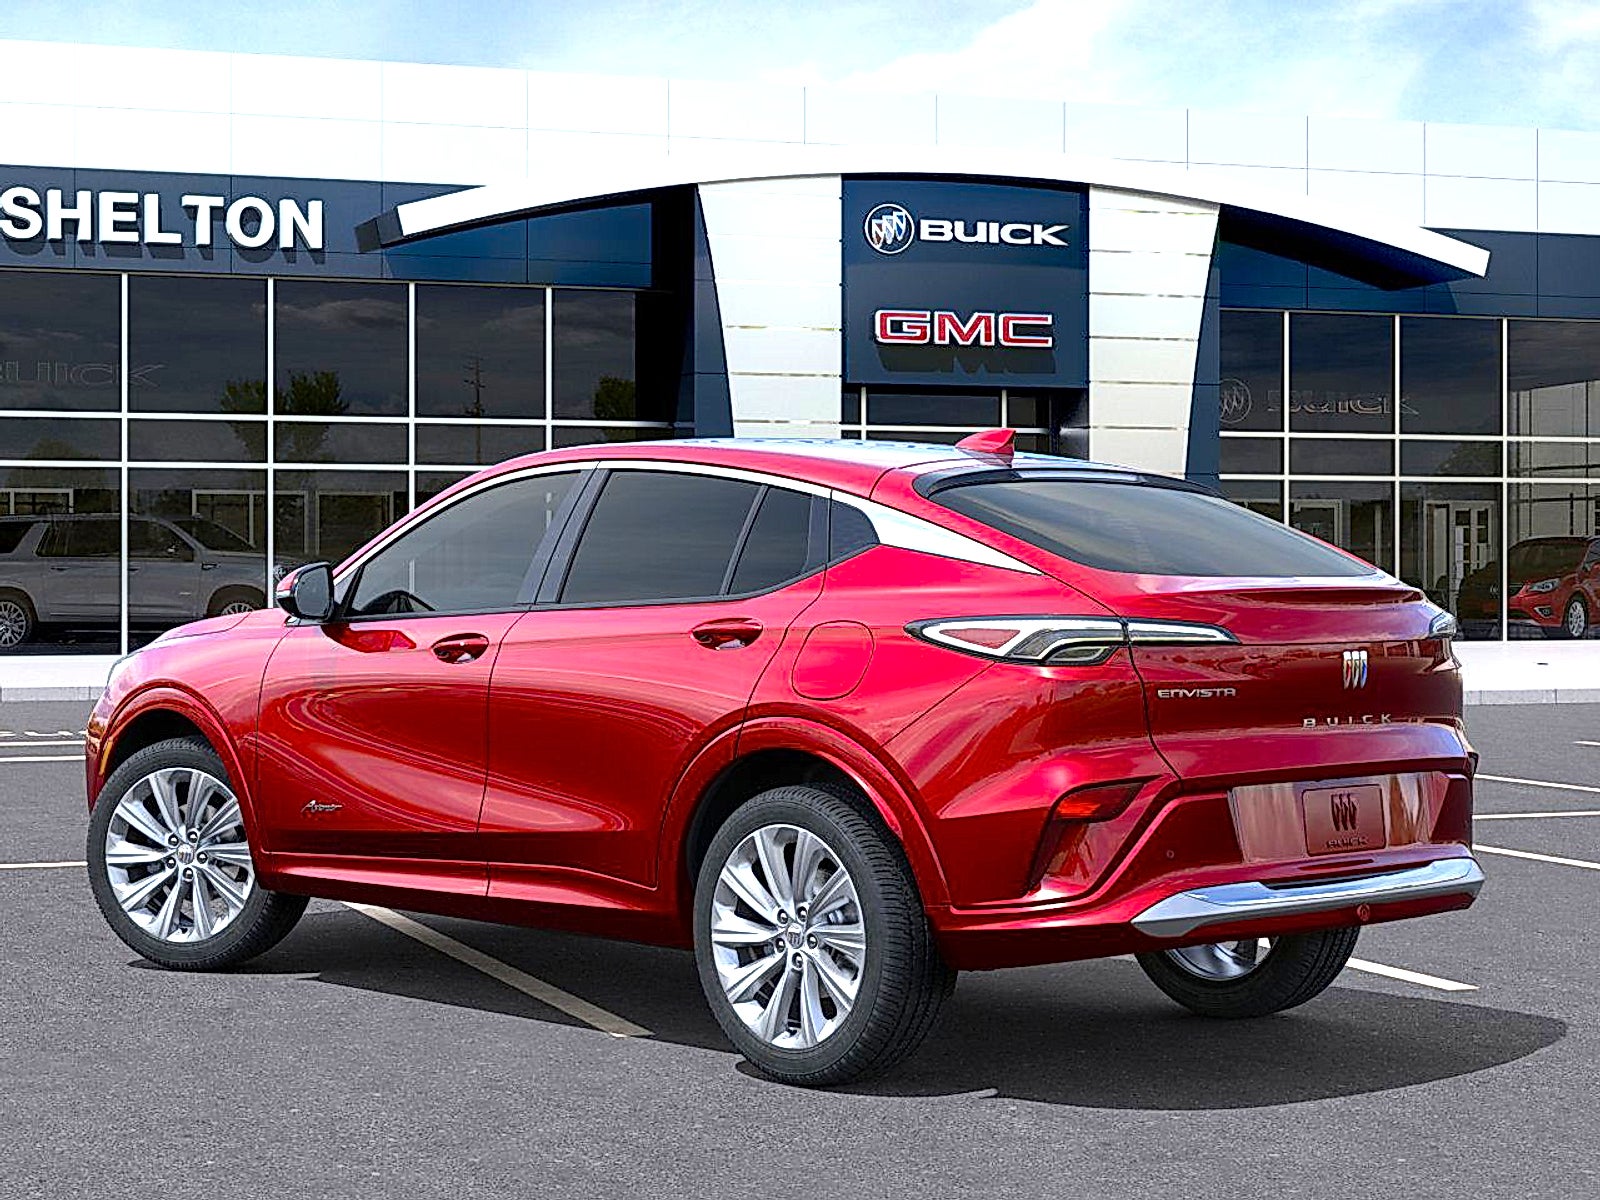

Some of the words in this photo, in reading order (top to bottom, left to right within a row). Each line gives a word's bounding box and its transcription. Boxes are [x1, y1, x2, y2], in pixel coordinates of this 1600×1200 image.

[0, 186, 324, 250] SHELTON
[920, 218, 1070, 247] BUICK
[875, 309, 1053, 348] GMC
[1157, 687, 1237, 699] ENVISTA
[1302, 713, 1392, 729] BUICK
